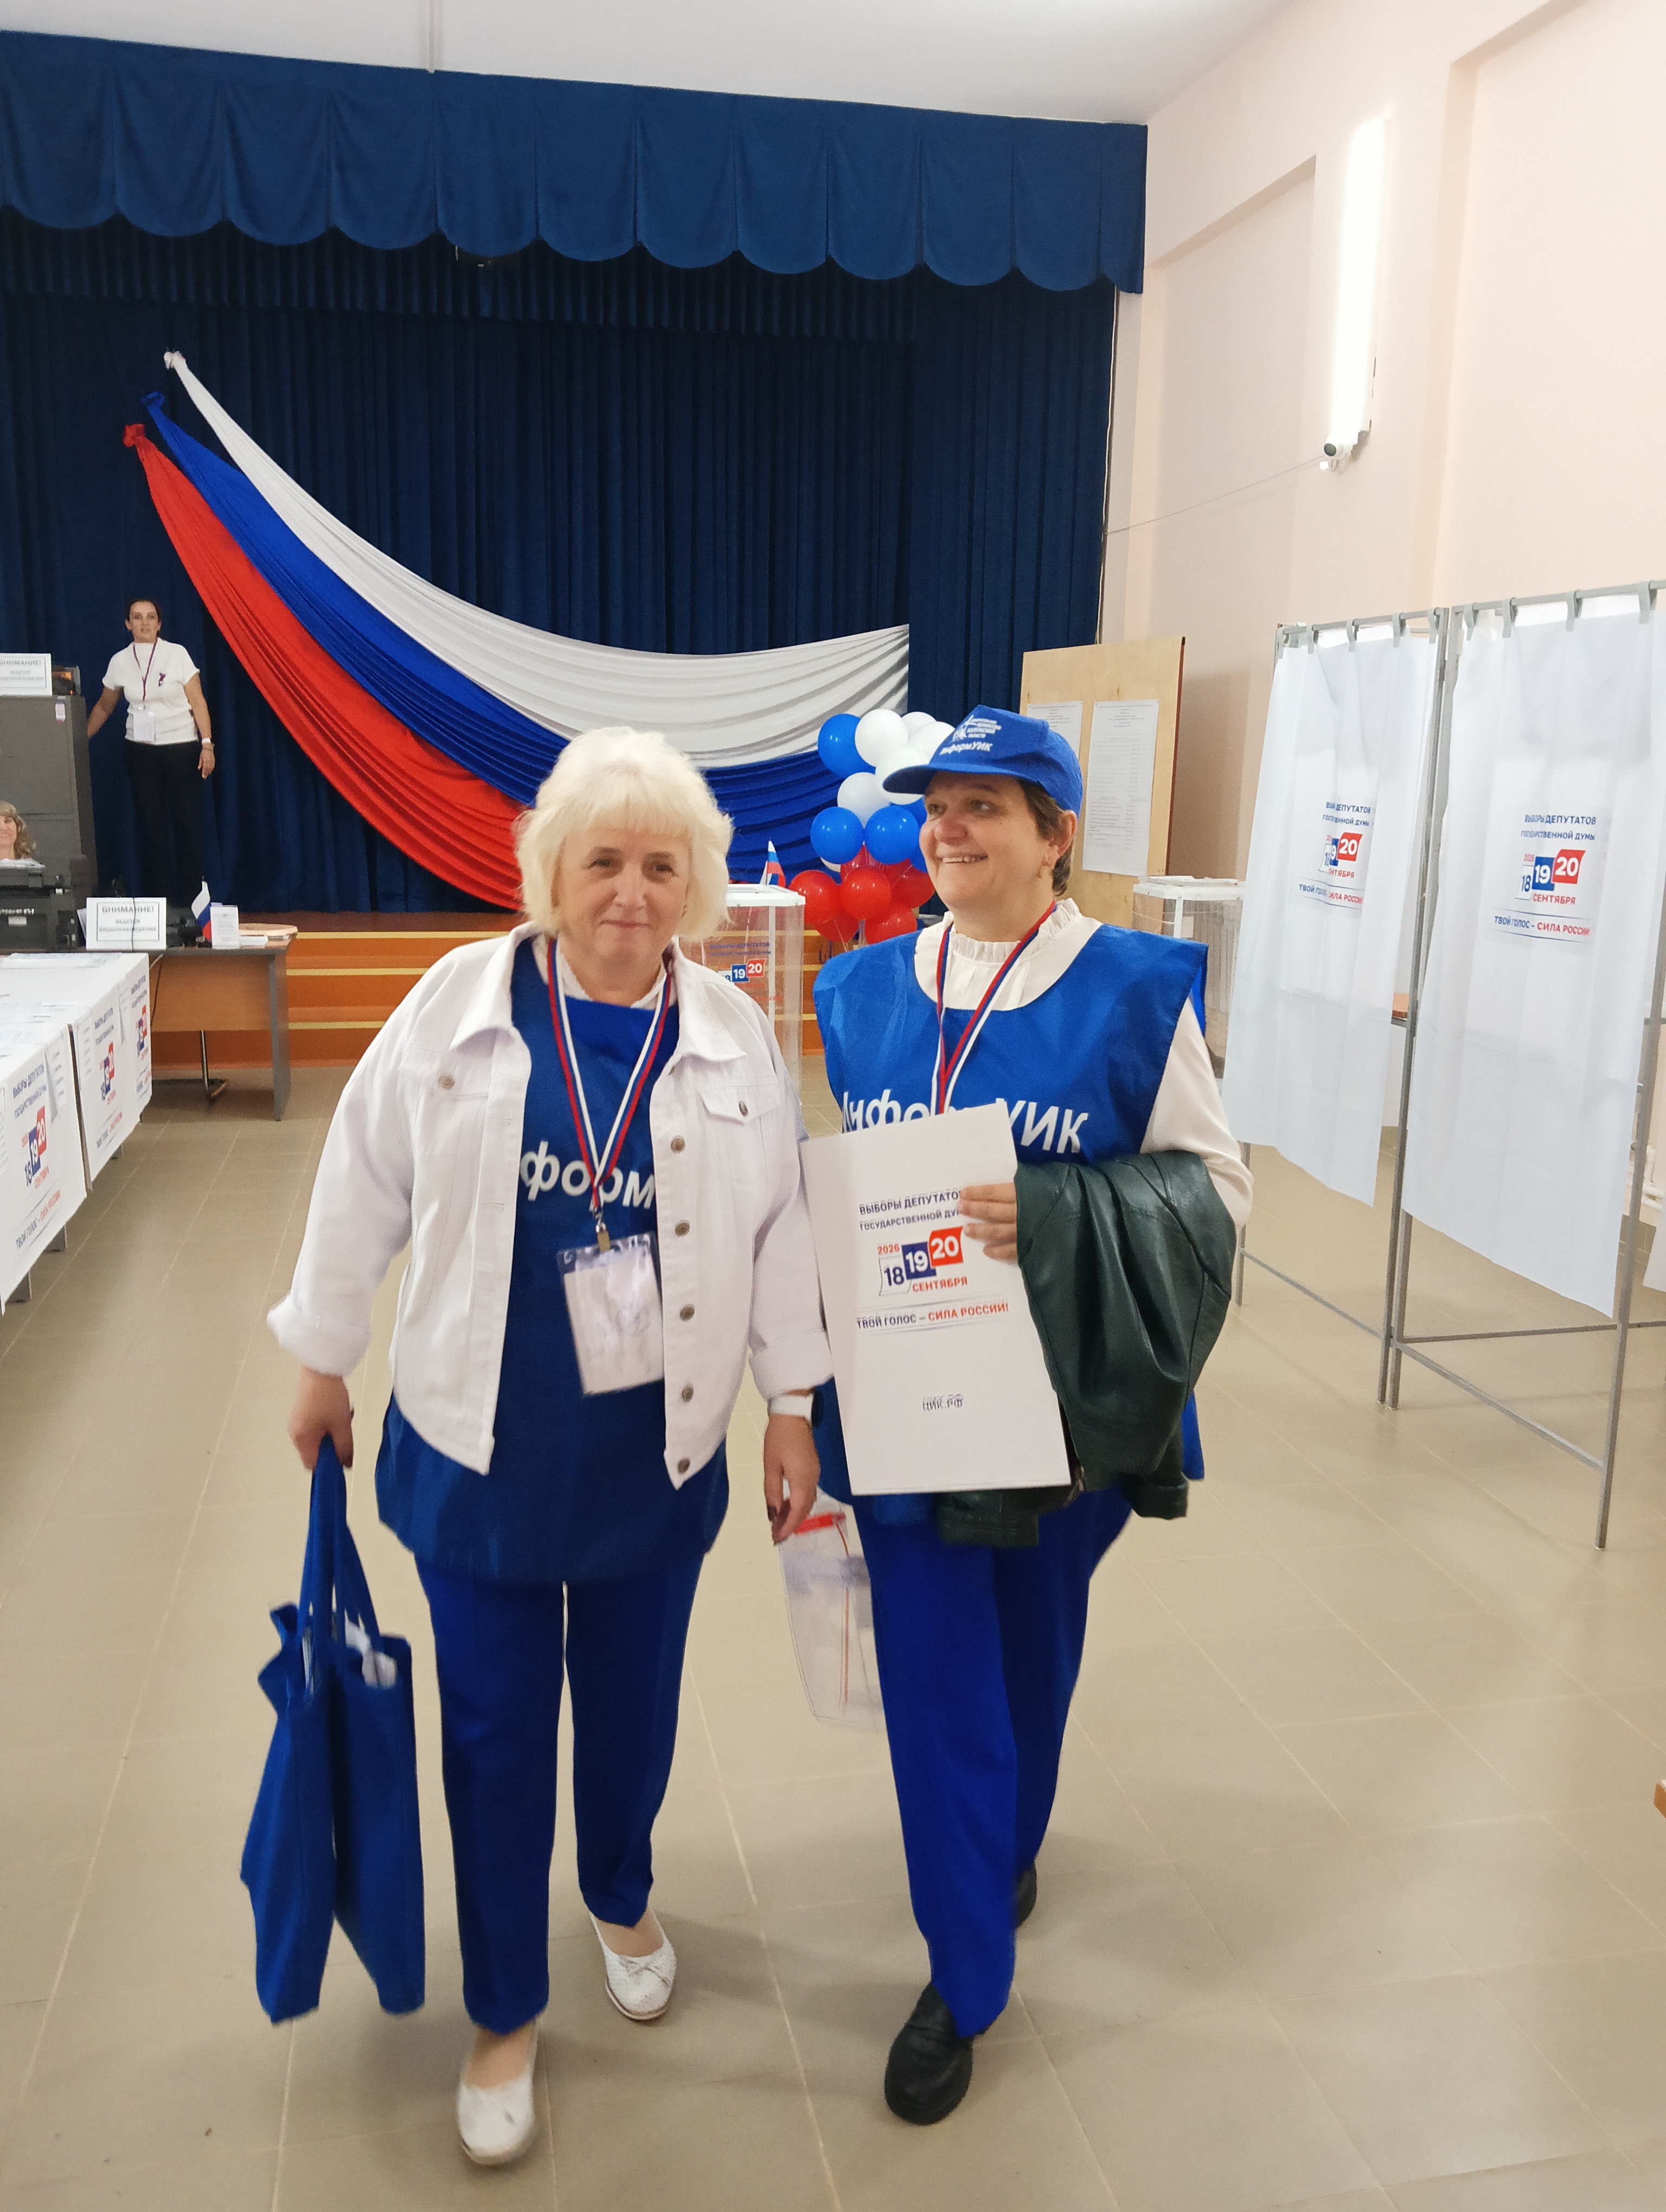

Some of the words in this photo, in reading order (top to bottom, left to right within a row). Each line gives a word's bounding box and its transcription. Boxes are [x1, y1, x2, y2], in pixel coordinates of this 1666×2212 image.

[1545, 815, 1596, 825] ДЕПУТАТОВ
[1339, 839, 1357, 855] 20
[1329, 869, 1355, 879] НТЯБРЯ
[1535, 864, 1550, 884] 19
[1555, 857, 1579, 877] 20
[1299, 884, 1315, 892] ТВОЙ
[1522, 875, 1531, 892] 18
[1533, 893, 1575, 905] СЕНТЯБРЯ
[1495, 916, 1510, 925] ТВОЙ
[1511, 918, 1530, 929] ГОЛОС
[1537, 922, 1560, 932] СИЛА
[733, 969, 745, 979] 19
[748, 963, 762, 974] 20
[37, 1118, 45, 1146] 20
[30, 1139, 38, 1165] 19
[24, 1161, 32, 1187] 18
[860, 1200, 901, 1215] ВЫБОРЫ
[905, 1189, 961, 1209] ДЕПУТАТО
[860, 1210, 942, 1231] ГОСУДАРСТВЕННОЙ
[944, 1209, 959, 1219] ДУ
[877, 1243, 900, 1255] 2026
[931, 1236, 959, 1260] 20
[906, 1250, 928, 1273] 19
[884, 1266, 905, 1286] 18
[913, 1276, 968, 1293] СЕНТЯБРЯ
[856, 1315, 882, 1329] ТВОЙ
[885, 1314, 916, 1328] ГОЛОС
[928, 1309, 958, 1321] СИЛА
[961, 1302, 1008, 1317] РОССИИ!
